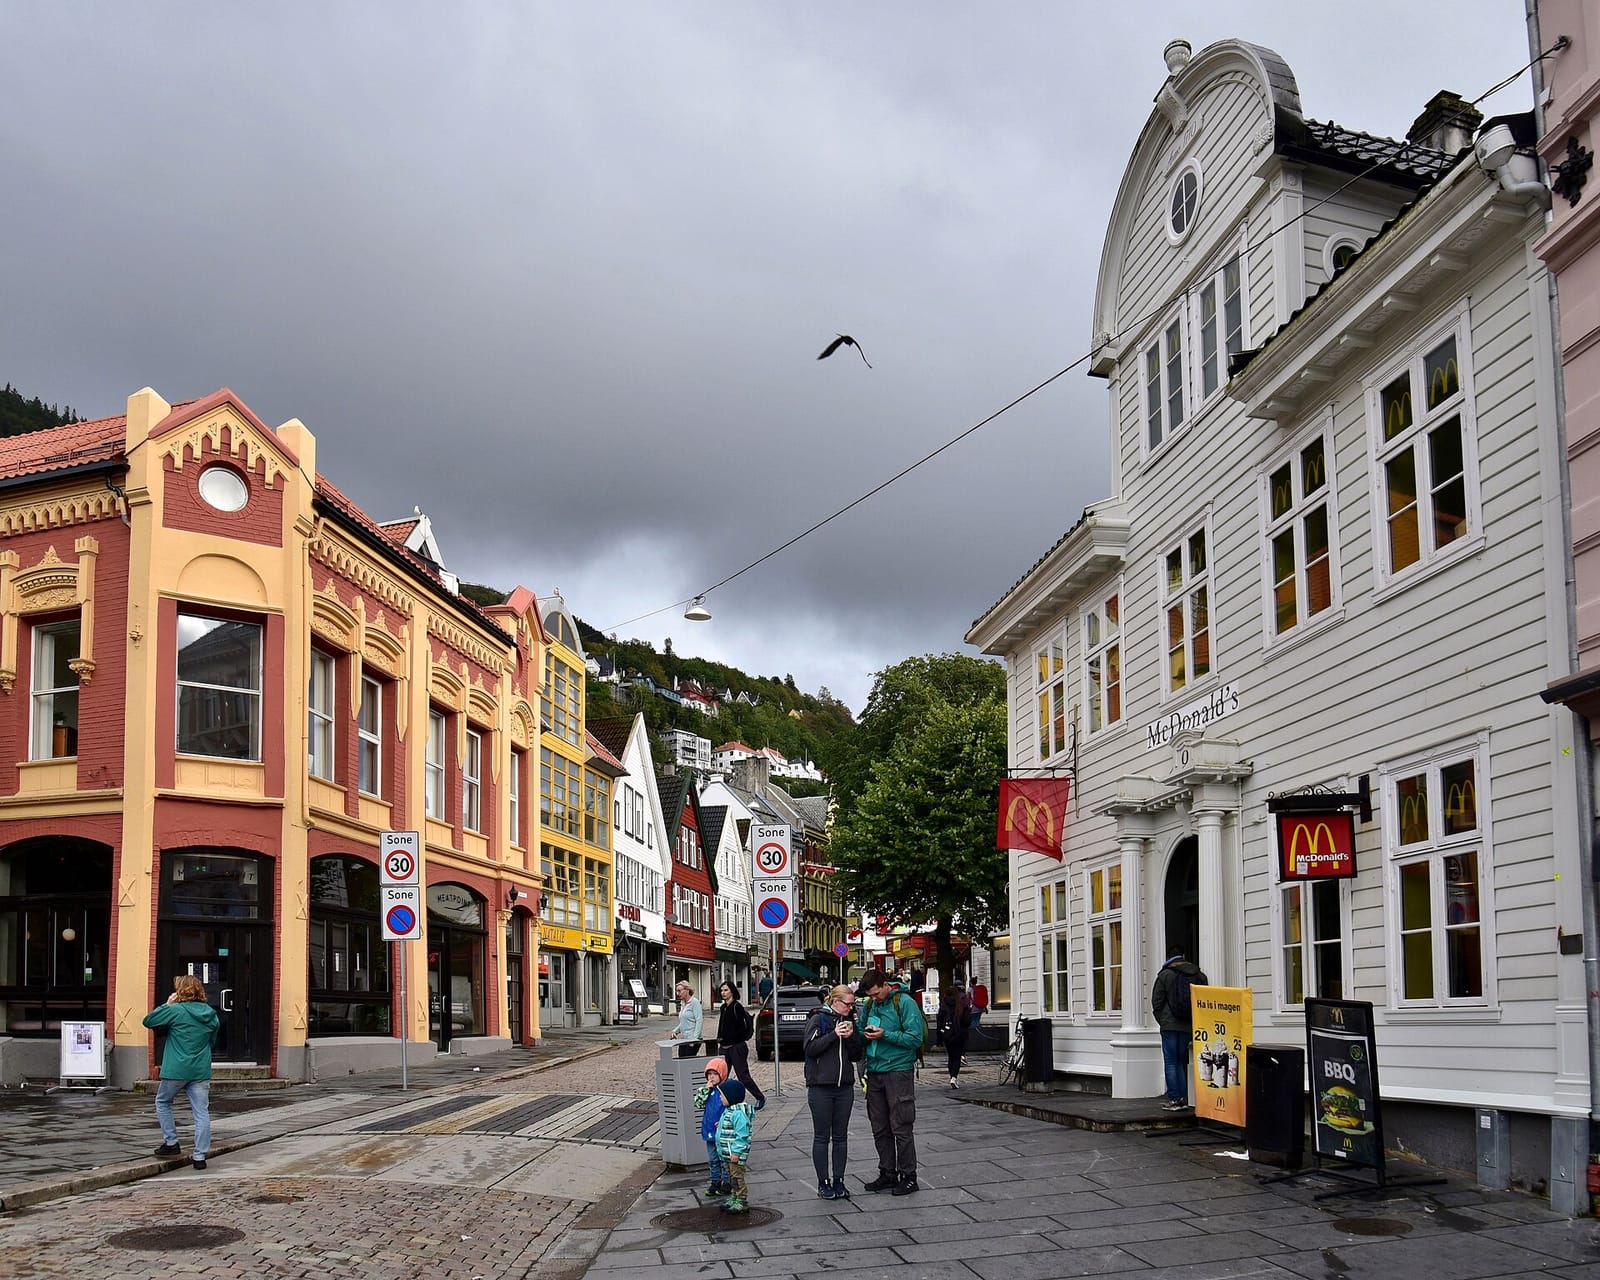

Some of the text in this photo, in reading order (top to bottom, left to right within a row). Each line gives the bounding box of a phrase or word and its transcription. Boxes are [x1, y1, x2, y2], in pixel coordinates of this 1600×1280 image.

[1147, 686, 1239, 749] McDonald's
[758, 828, 785, 837] Sone
[387, 835, 413, 845] Sone
[762, 851, 782, 866] 30
[1296, 852, 1349, 862] McDonald's
[390, 858, 410, 873] 30
[760, 883, 787, 892] Sone
[388, 890, 413, 900] Sone
[543, 927, 566, 944] NATALIE
[1197, 1000, 1206, 1008] Ha
[1207, 1000, 1214, 1009] is
[1217, 1003, 1241, 1013] magen
[1214, 1023, 1226, 1036] 30
[1194, 1030, 1208, 1042] 20
[1233, 1039, 1242, 1051] 25
[1324, 1060, 1356, 1085] BBQ
